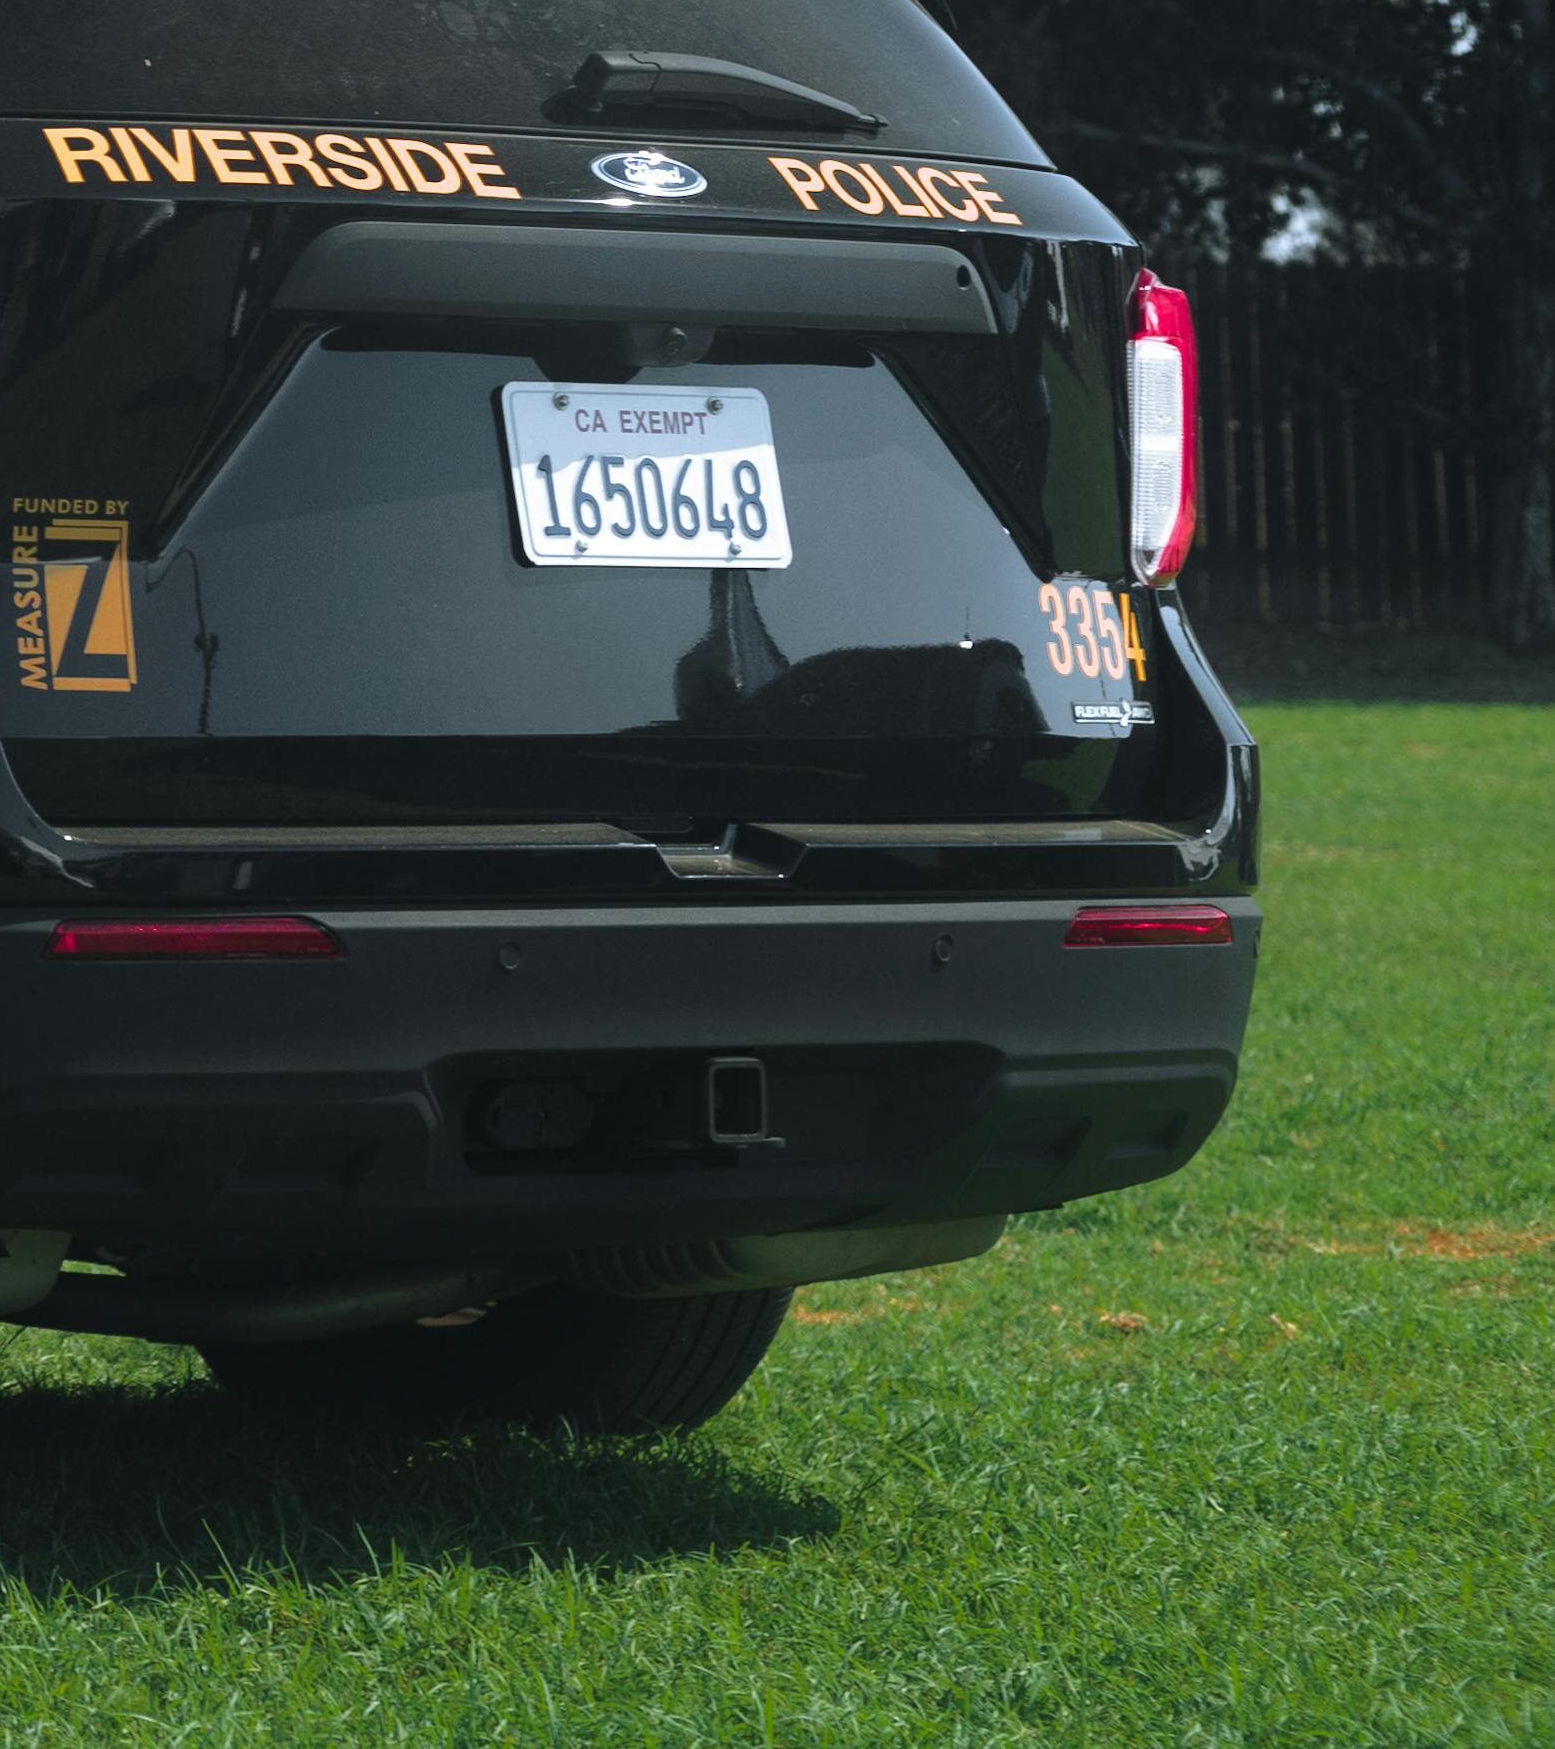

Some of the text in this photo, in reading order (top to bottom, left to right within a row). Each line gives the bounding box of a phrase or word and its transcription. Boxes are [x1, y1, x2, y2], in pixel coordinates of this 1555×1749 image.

[43, 127, 1023, 225] RIVERSIDE POLICE
[575, 409, 708, 434] CA EXEMPT
[12, 498, 129, 515] FUNDED BY
[538, 454, 767, 539] 1650648
[12, 525, 48, 690] MEASURE
[1039, 583, 1146, 682] 3354
